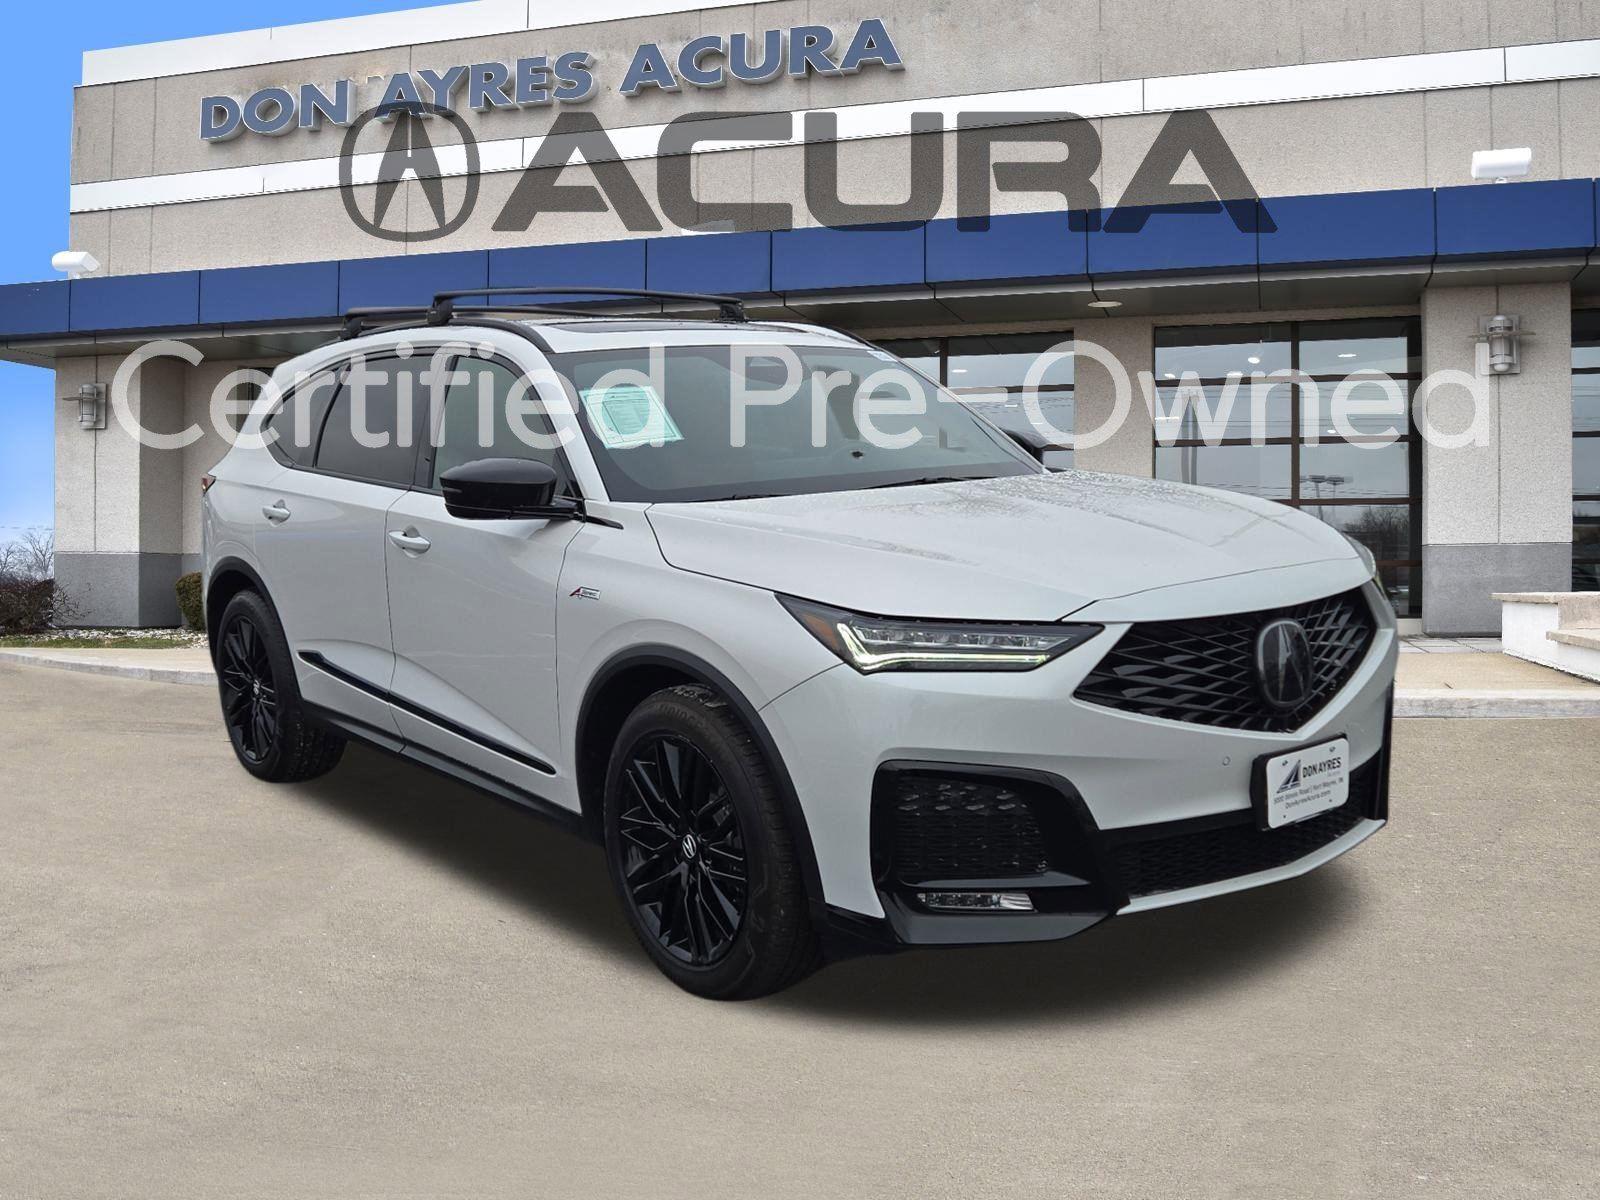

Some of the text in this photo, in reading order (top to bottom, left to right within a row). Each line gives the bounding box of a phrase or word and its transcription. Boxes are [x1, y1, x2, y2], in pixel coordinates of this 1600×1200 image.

[200, 18, 904, 143] DON AYRES ACURA
[1302, 764, 1318, 778] DON
[1319, 757, 1341, 773] AYRES
